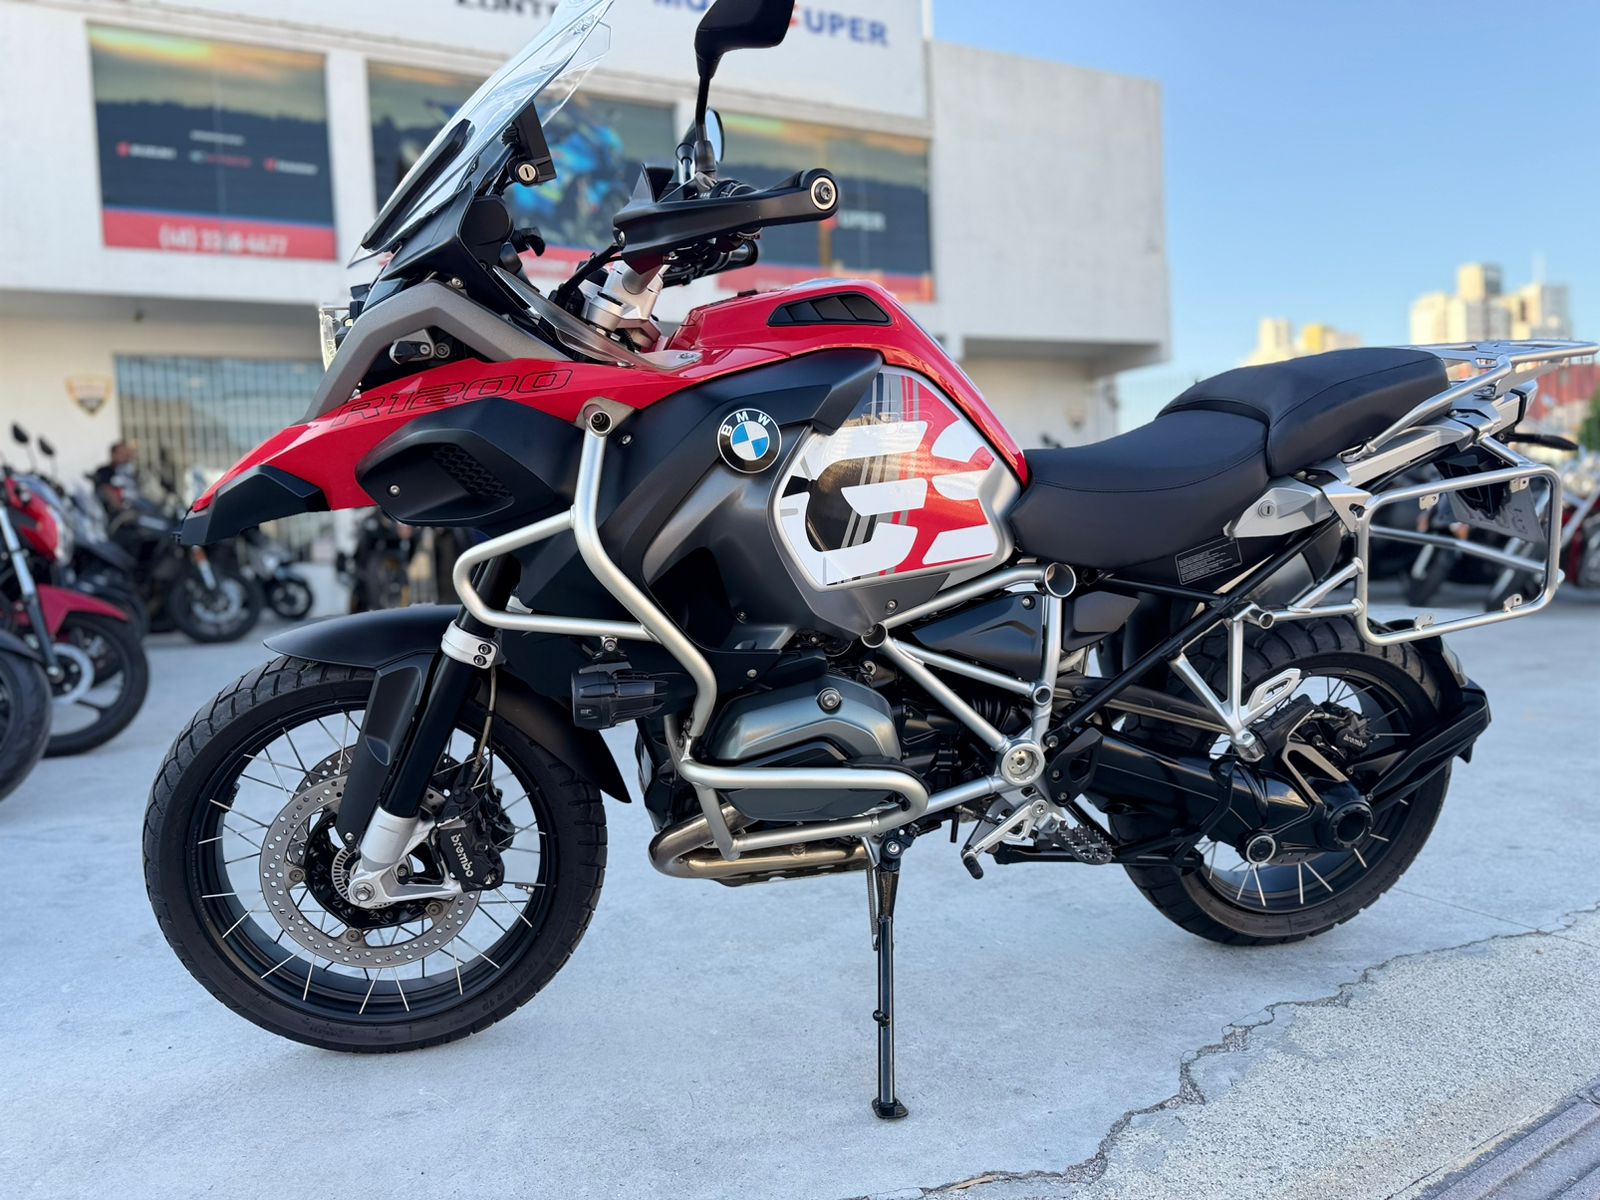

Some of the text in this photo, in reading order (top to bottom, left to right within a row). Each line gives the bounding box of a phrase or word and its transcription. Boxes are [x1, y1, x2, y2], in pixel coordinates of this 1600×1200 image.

[331, 369, 573, 427] R1200
[721, 410, 770, 436] BMW
[450, 833, 474, 877] brembo
